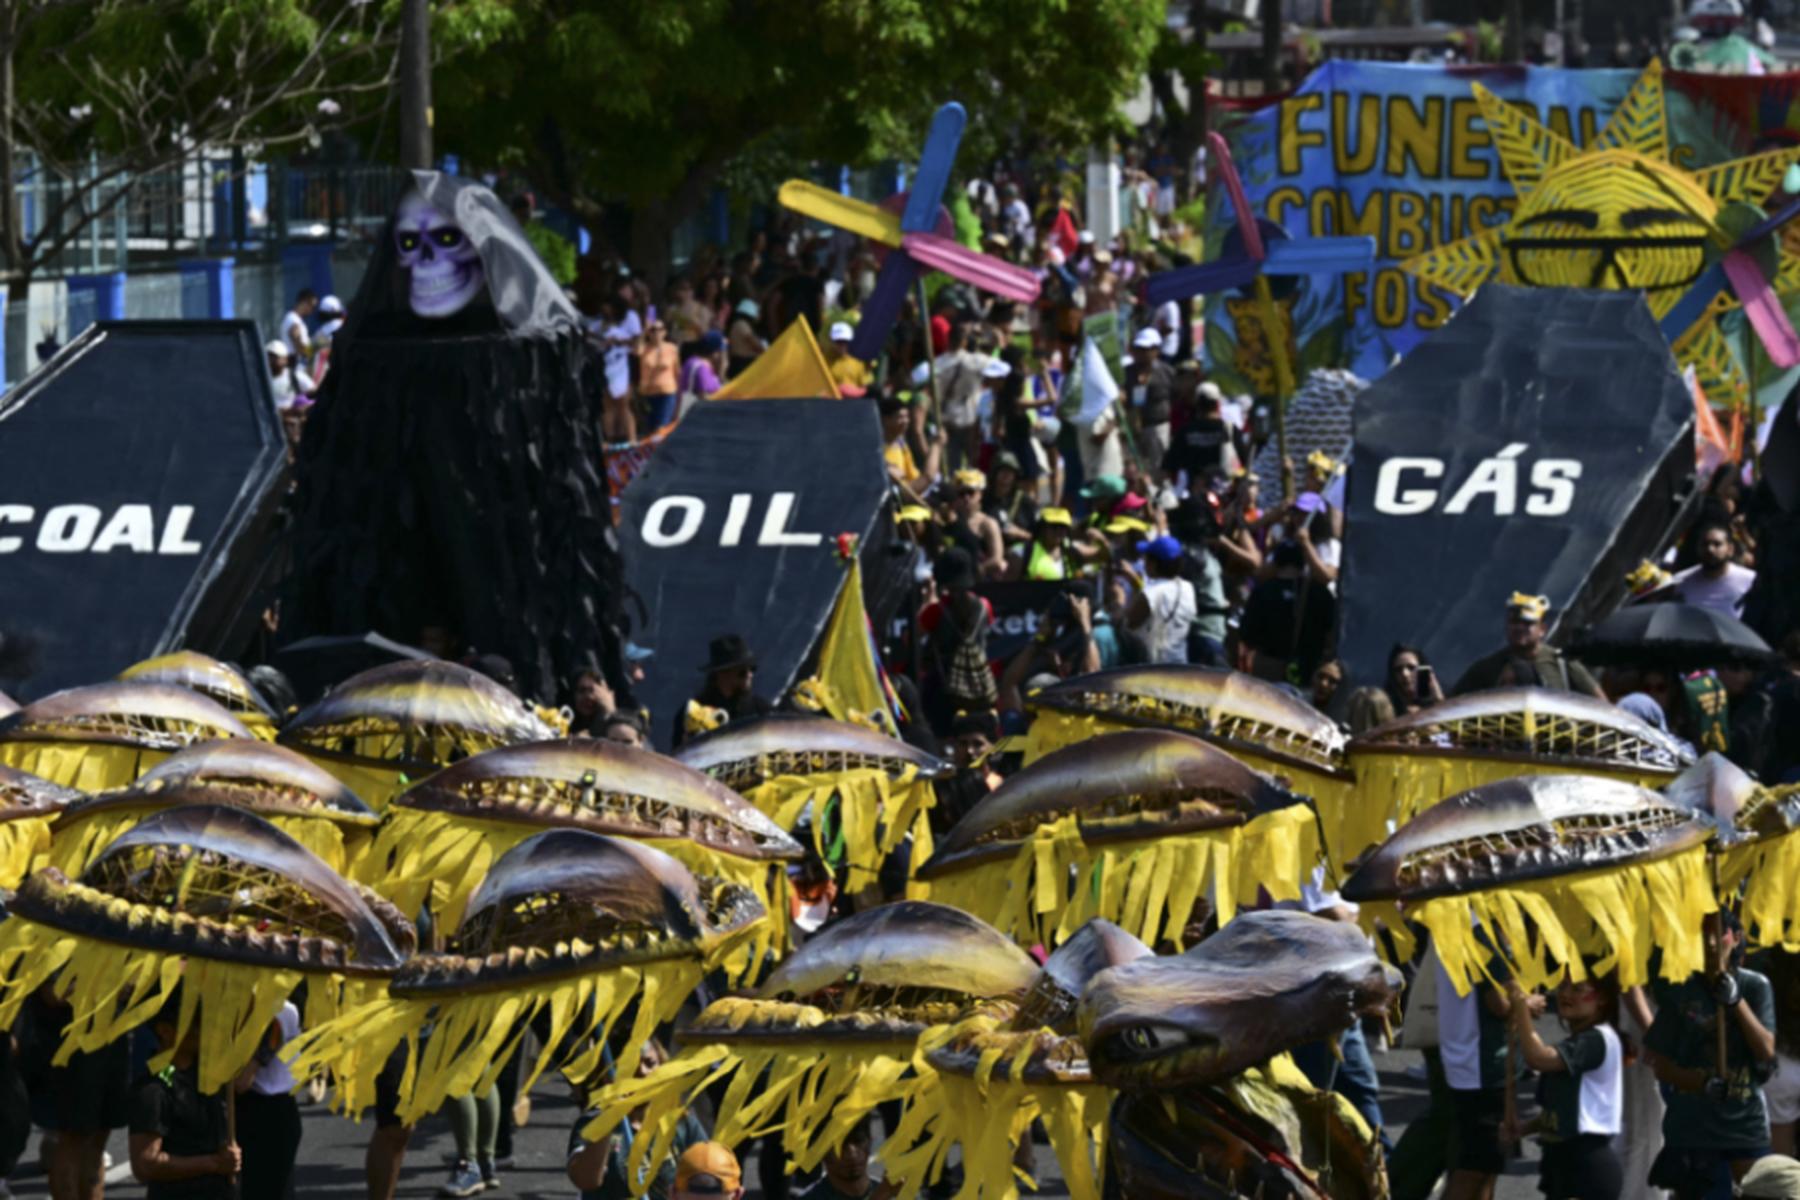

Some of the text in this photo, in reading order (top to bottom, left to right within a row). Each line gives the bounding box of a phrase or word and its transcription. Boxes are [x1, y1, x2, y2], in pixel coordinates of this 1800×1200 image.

[1374, 442, 1583, 516] GÁS
[0, 504, 202, 554] COAL
[641, 492, 823, 547] OIL
